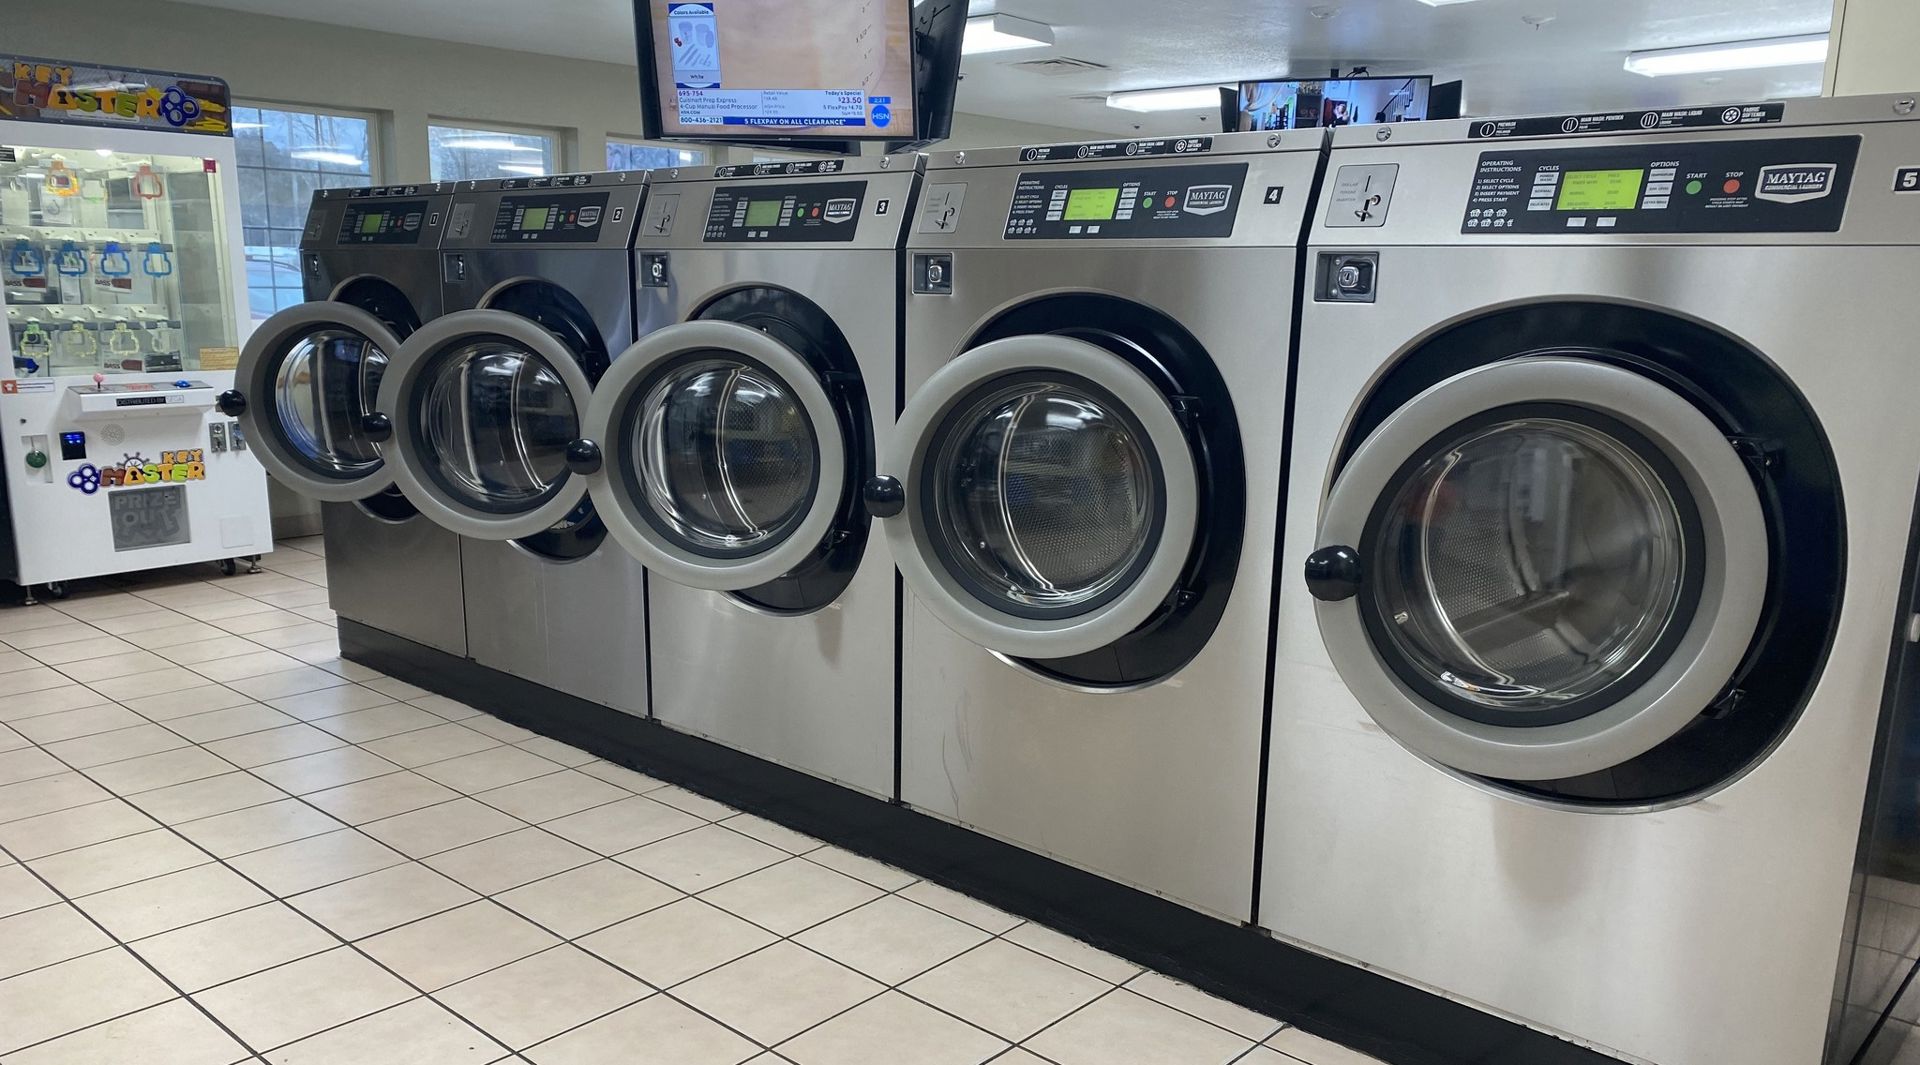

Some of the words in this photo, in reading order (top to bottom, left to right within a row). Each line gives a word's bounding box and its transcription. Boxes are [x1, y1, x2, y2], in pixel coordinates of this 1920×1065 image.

[14, 63, 73, 86] KEY
[13, 79, 160, 118] MASTER
[1766, 171, 1826, 184] MAYTAG
[1902, 172, 1918, 188] 5
[1190, 191, 1226, 201] MAYTAG
[1268, 190, 1279, 201] 4
[828, 203, 852, 211] MAYTAG
[878, 202, 886, 212] 3
[615, 210, 621, 219] 2
[161, 448, 204, 464] KEY
[100, 461, 206, 487] MASTER
